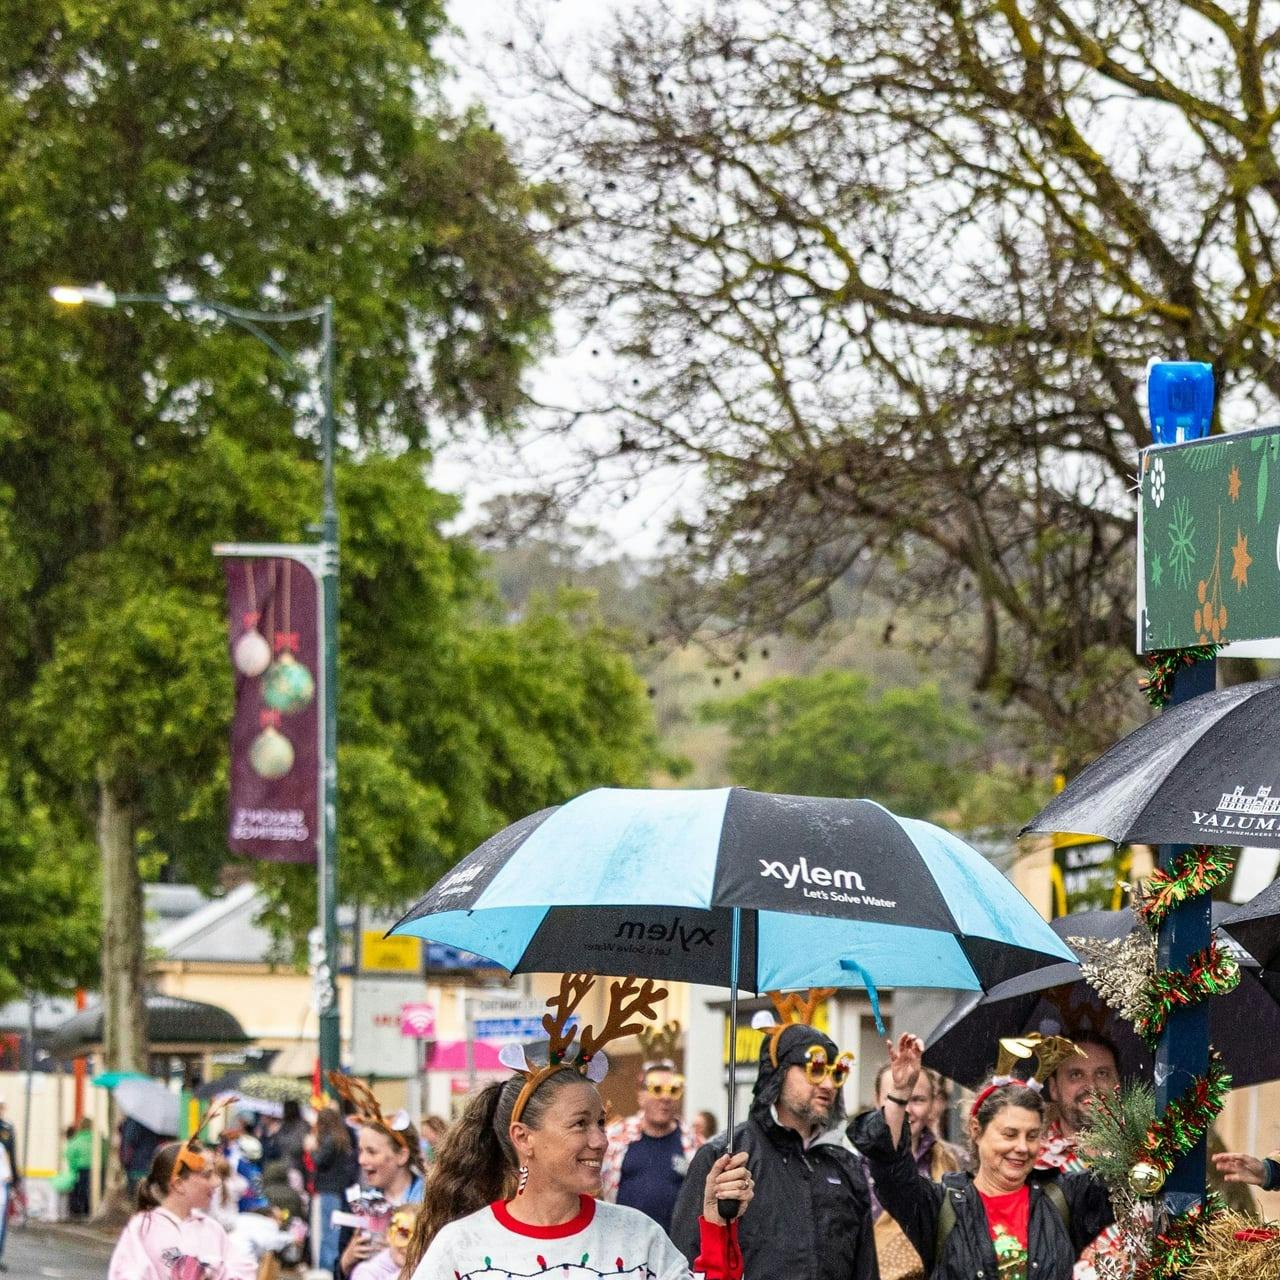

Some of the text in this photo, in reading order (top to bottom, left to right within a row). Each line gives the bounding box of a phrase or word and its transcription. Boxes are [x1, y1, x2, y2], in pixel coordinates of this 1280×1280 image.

[758, 856, 866, 891] xylem
[803, 887, 897, 908] Let's Solve Water
